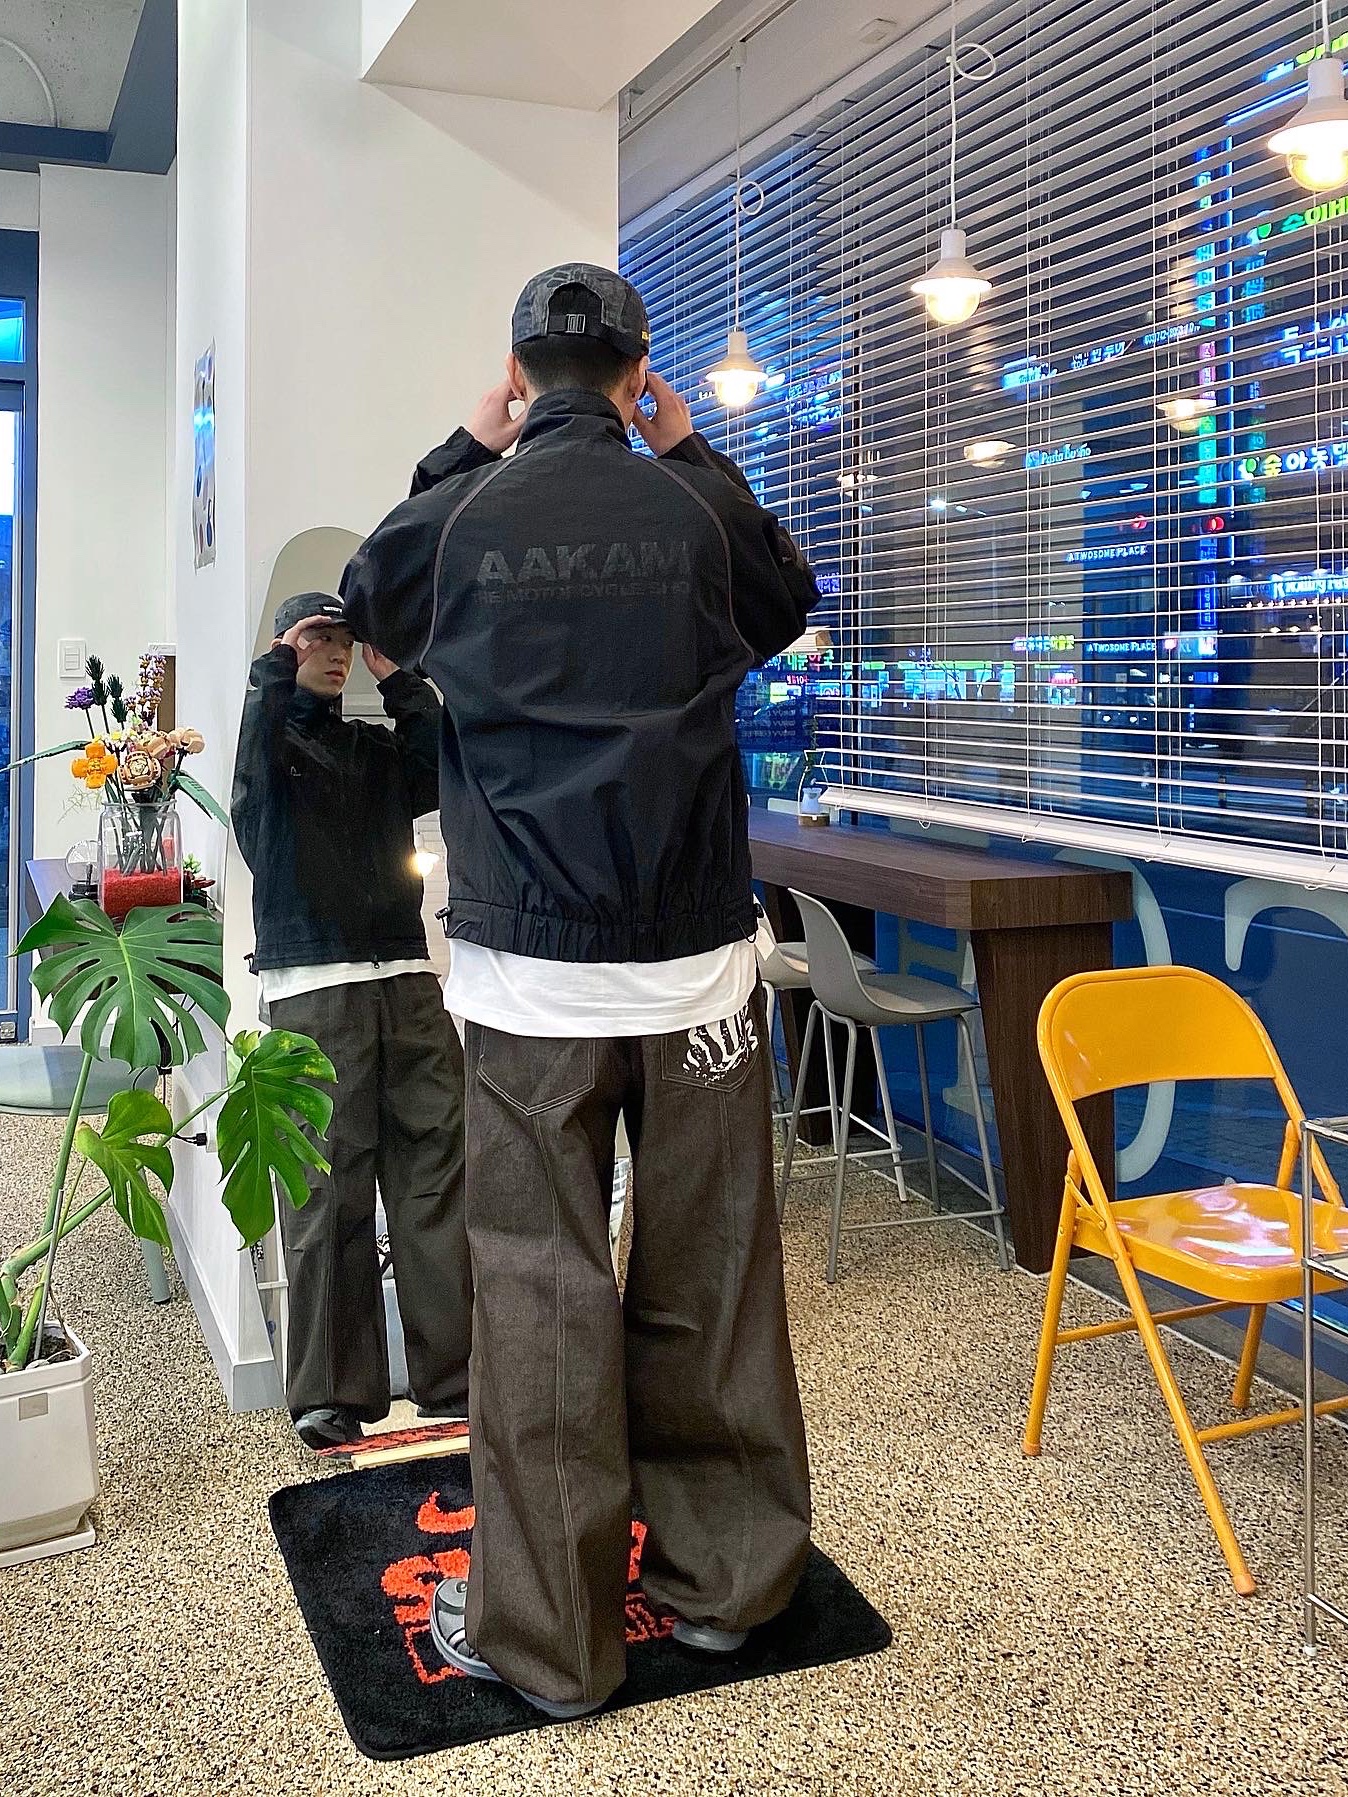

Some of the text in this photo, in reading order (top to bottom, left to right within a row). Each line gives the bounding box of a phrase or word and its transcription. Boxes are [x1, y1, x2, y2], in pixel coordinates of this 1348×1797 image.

[1041, 449, 1063, 464] Pasta
[1116, 545, 1146, 557] PLACE
[1130, 641, 1156, 651] PLACE
